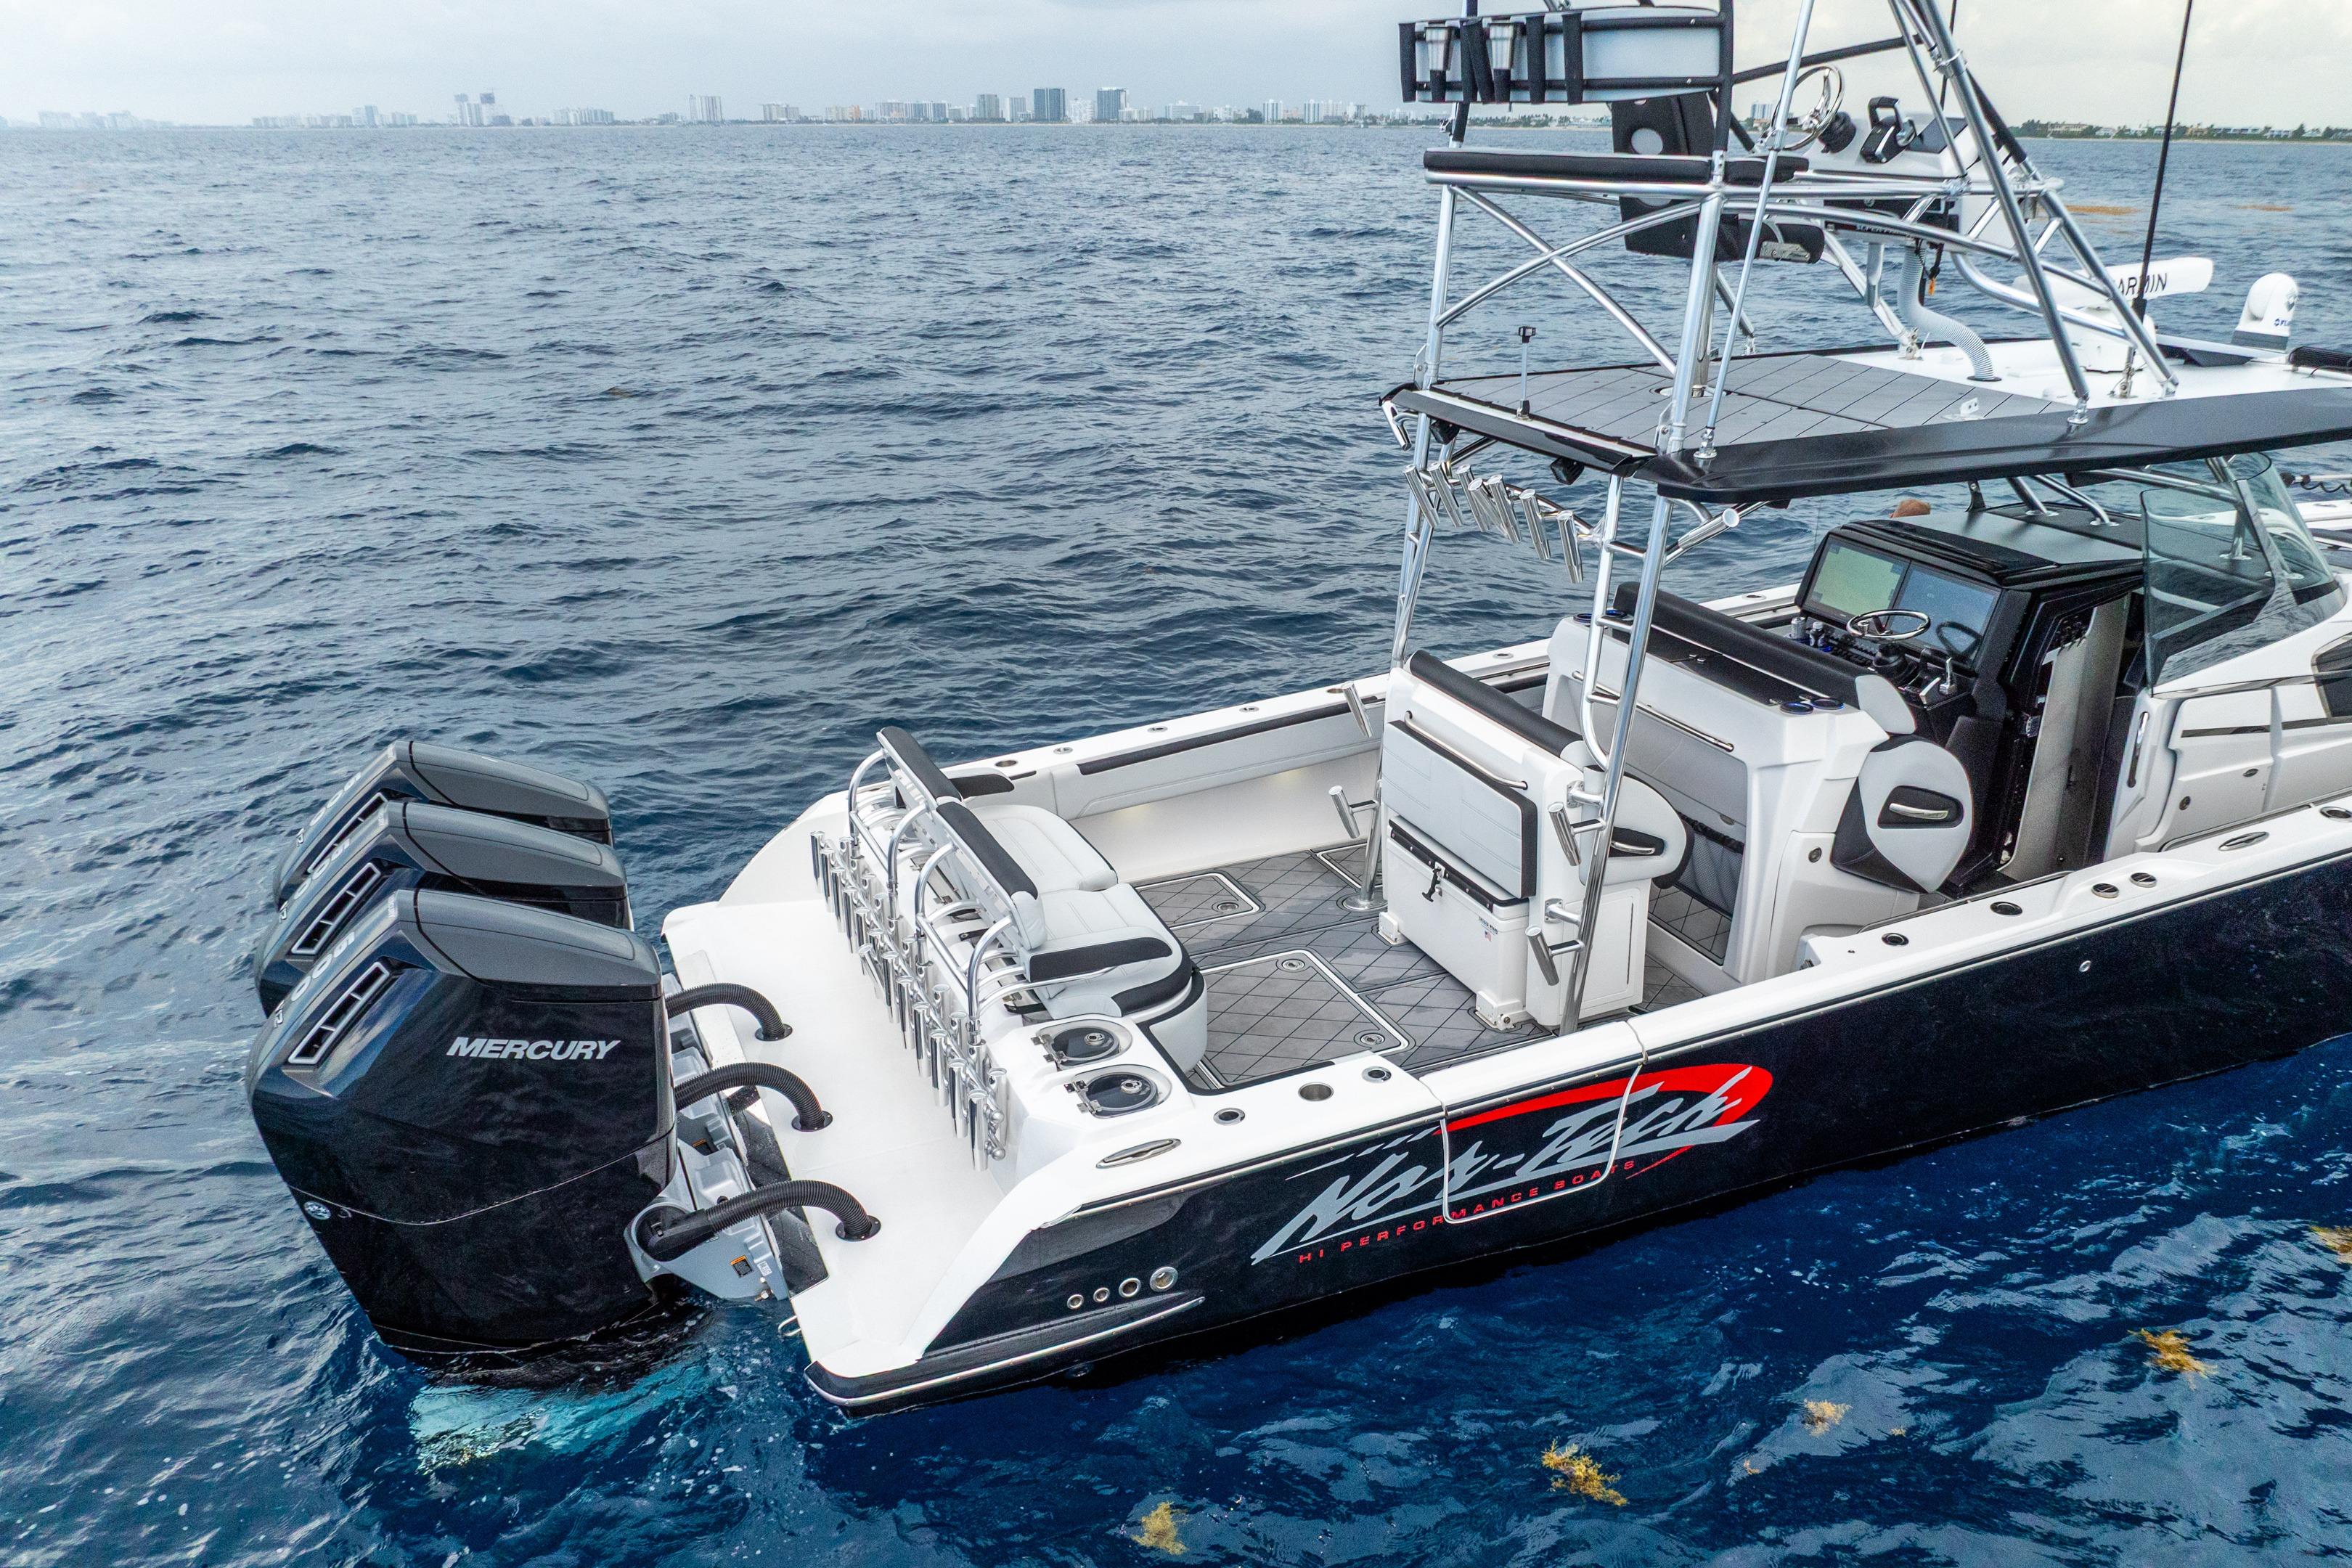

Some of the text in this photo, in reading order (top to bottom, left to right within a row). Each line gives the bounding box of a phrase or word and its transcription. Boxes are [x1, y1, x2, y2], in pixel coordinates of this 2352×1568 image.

[2118, 272, 2168, 296] ARIN
[446, 1037, 621, 1060] MERCURY
[1299, 1161, 1635, 1264] HI PERFORMANCE BOATS
